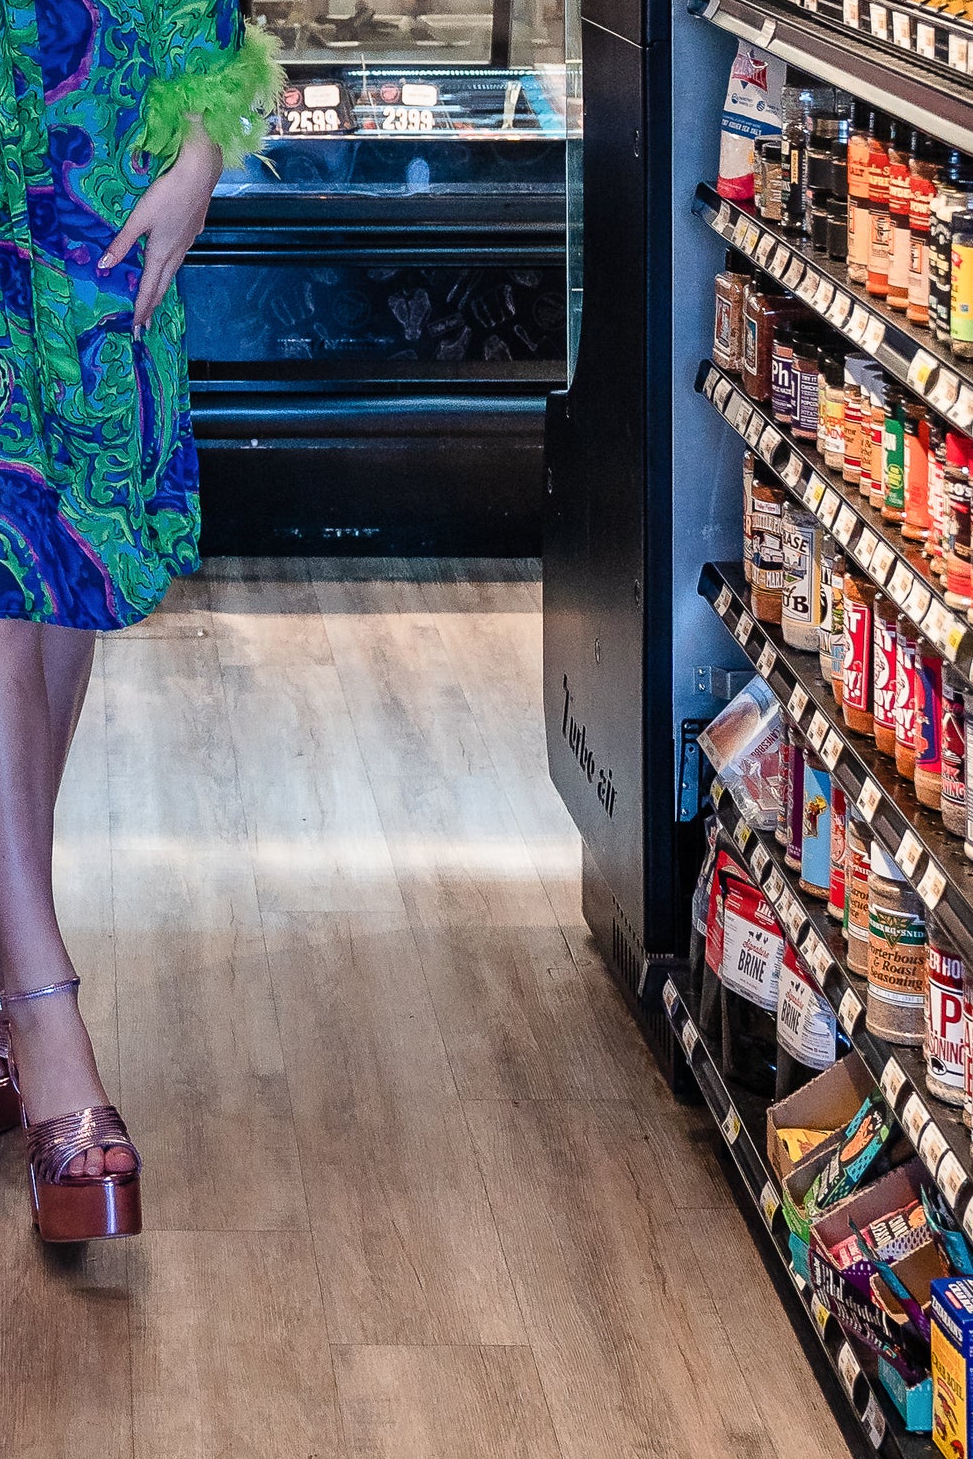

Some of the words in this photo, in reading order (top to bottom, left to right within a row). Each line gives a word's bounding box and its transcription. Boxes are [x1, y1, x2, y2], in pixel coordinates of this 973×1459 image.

[382, 109, 434, 132] 2399
[597, 768, 618, 819] air
[737, 950, 768, 984] BRINE
[882, 959, 918, 977] Roast
[780, 998, 802, 1036] BRINE
